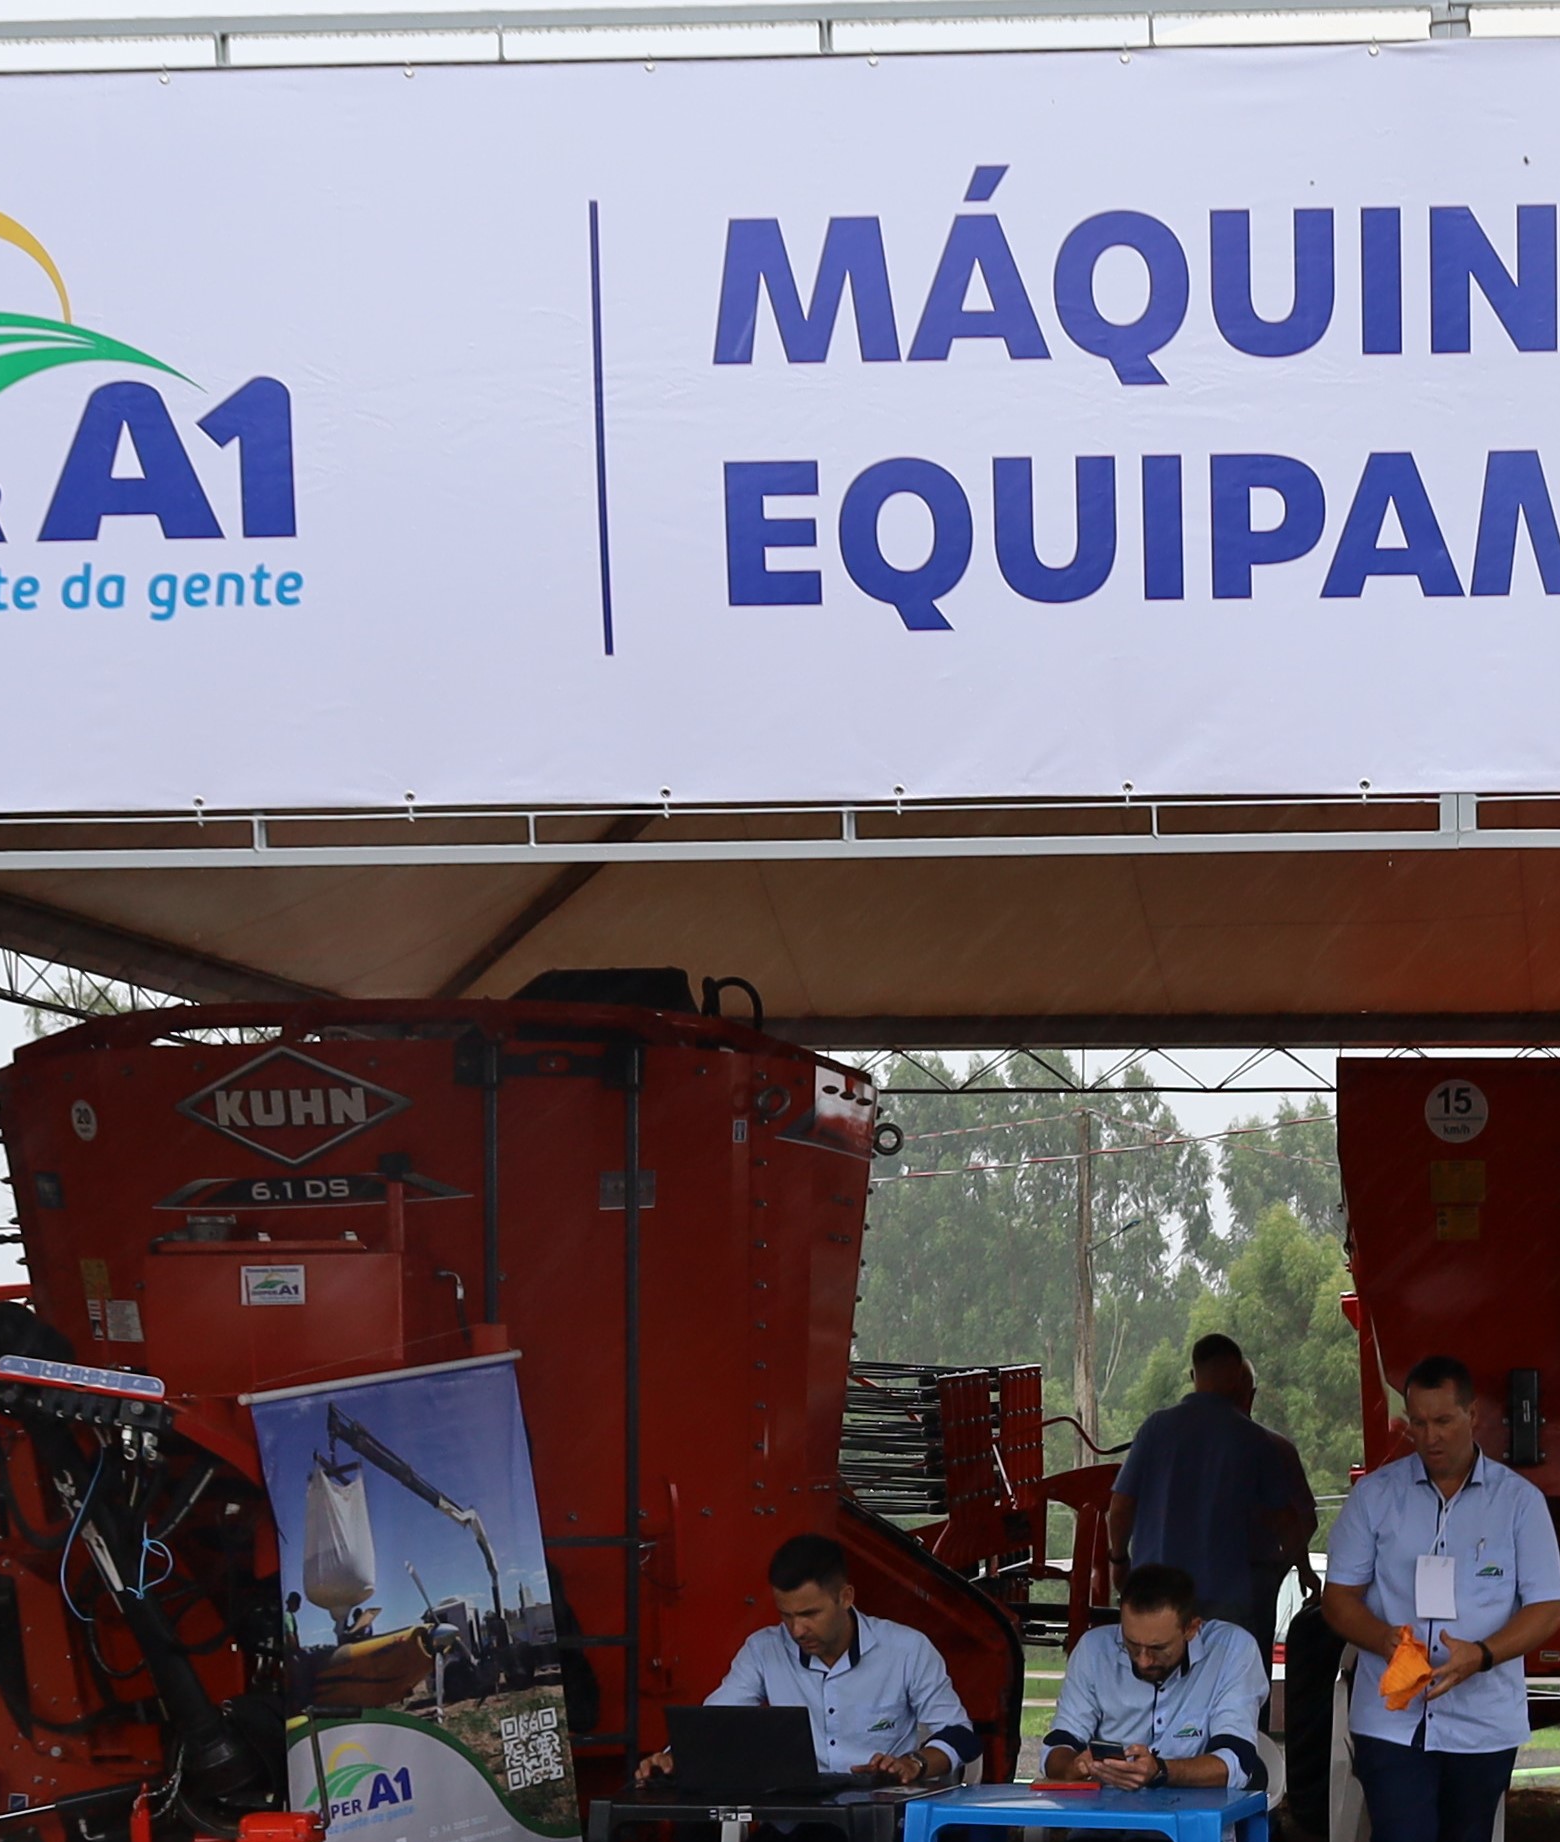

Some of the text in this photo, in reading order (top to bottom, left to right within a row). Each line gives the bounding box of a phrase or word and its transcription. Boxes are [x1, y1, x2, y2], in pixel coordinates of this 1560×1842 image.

[37, 377, 297, 543] A1
[62, 562, 126, 611] da
[149, 564, 304, 622] gente
[214, 1086, 368, 1128] KUHN
[1437, 1087, 1473, 1115] 15
[251, 1179, 350, 1200] 6.1 DS
[367, 1766, 413, 1811] A1
